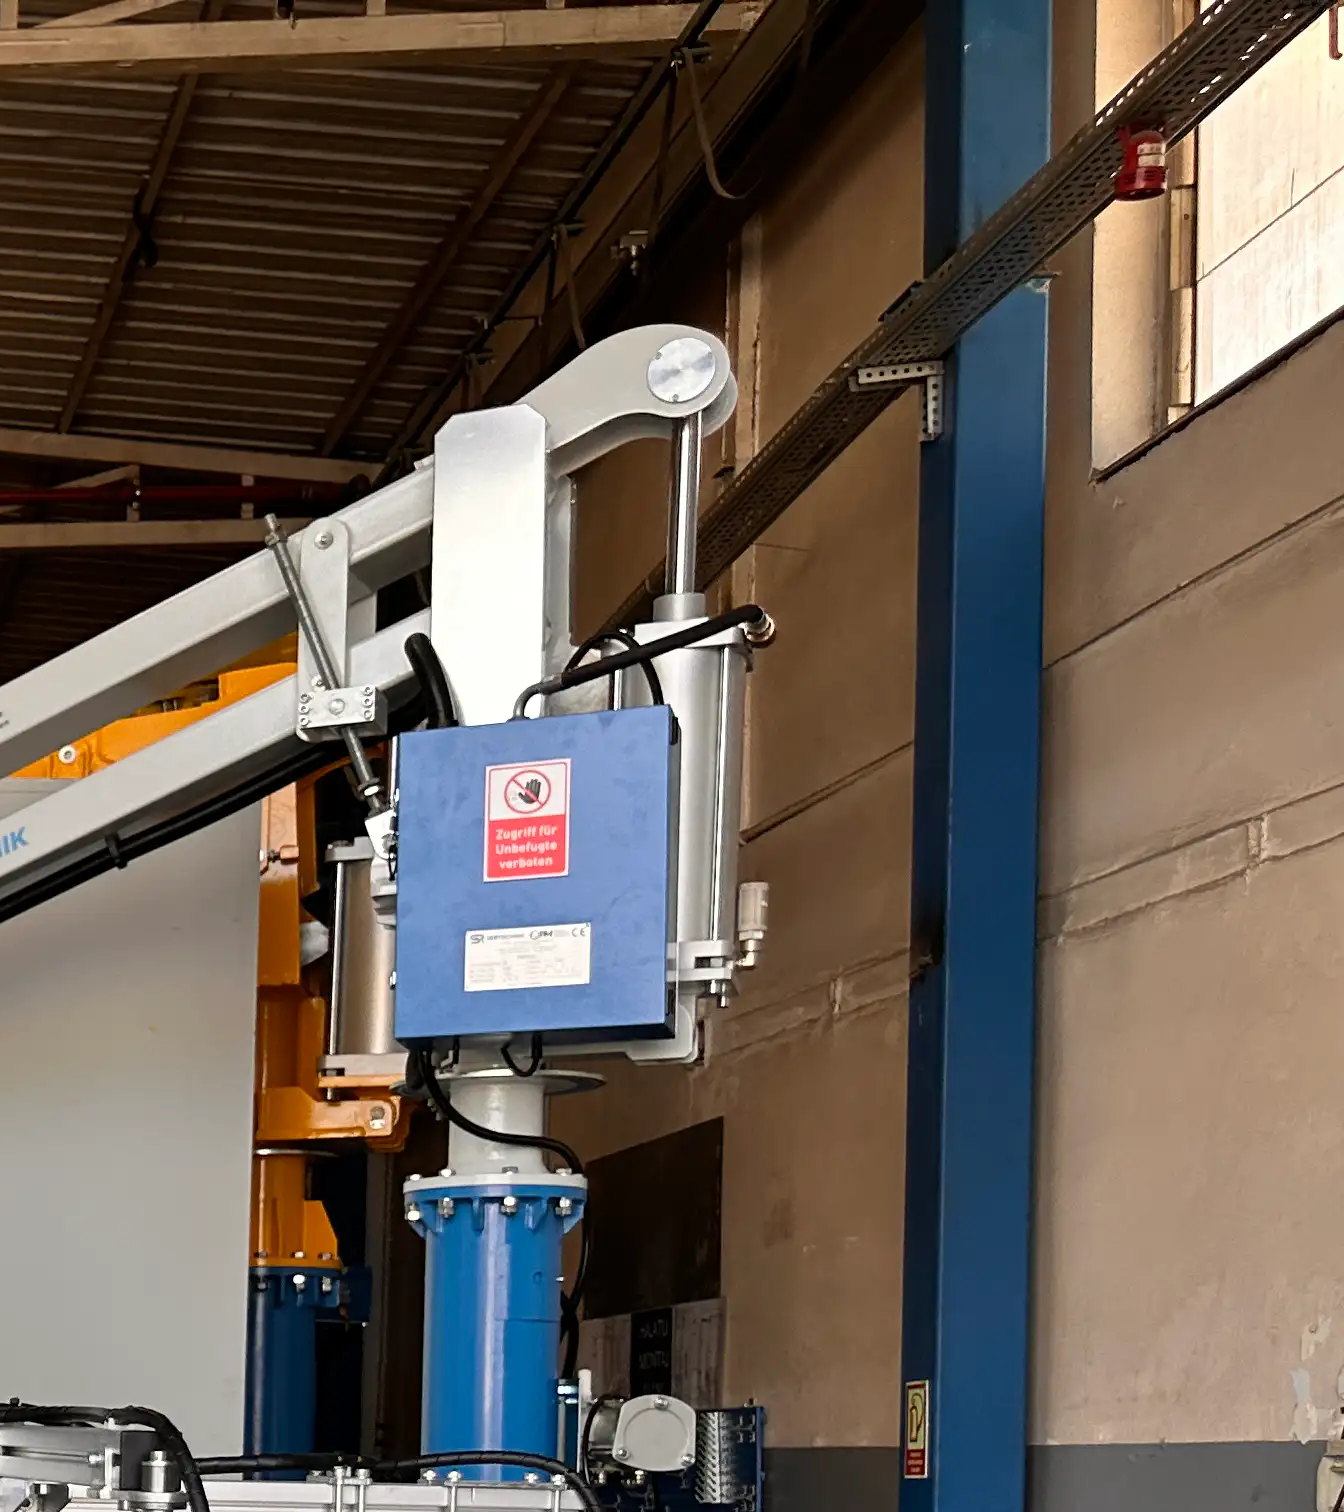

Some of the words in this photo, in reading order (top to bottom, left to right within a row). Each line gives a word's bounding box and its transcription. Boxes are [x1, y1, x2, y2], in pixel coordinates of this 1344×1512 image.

[495, 826, 537, 841] Zugriff
[539, 823, 558, 837] für
[495, 841, 558, 855] Unbefugte
[498, 857, 554, 869] verboten
